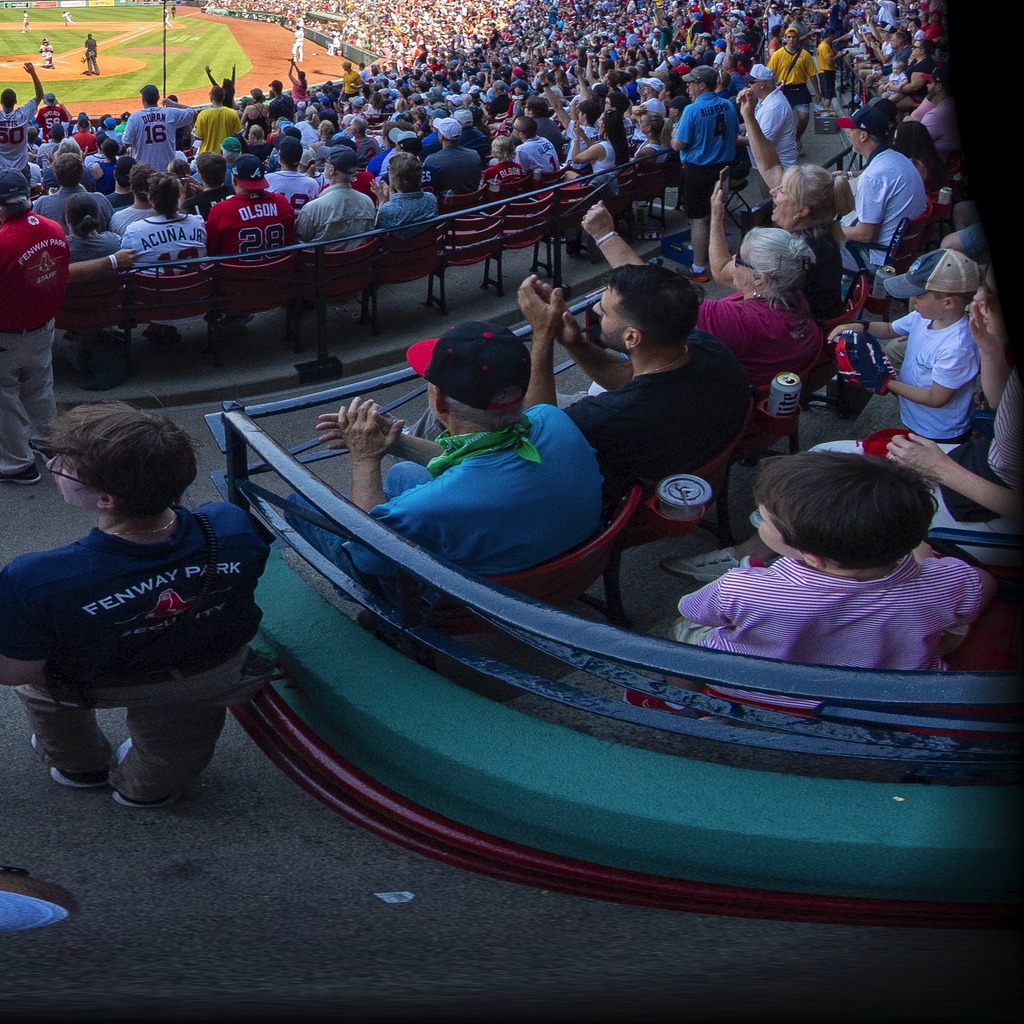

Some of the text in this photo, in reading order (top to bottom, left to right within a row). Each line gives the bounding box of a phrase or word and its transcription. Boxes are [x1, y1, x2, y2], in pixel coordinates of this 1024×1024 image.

[142, 114, 166, 124] DURAN
[714, 113, 727, 140] 4
[144, 124, 167, 144] 16
[238, 203, 279, 221] OLSON
[141, 225, 187, 251] ACUÑA
[238, 223, 285, 262] 28
[17, 238, 67, 265] FENWAY PARK
[36, 270, 57, 284] STAFF
[81, 569, 178, 616] FENWAY
